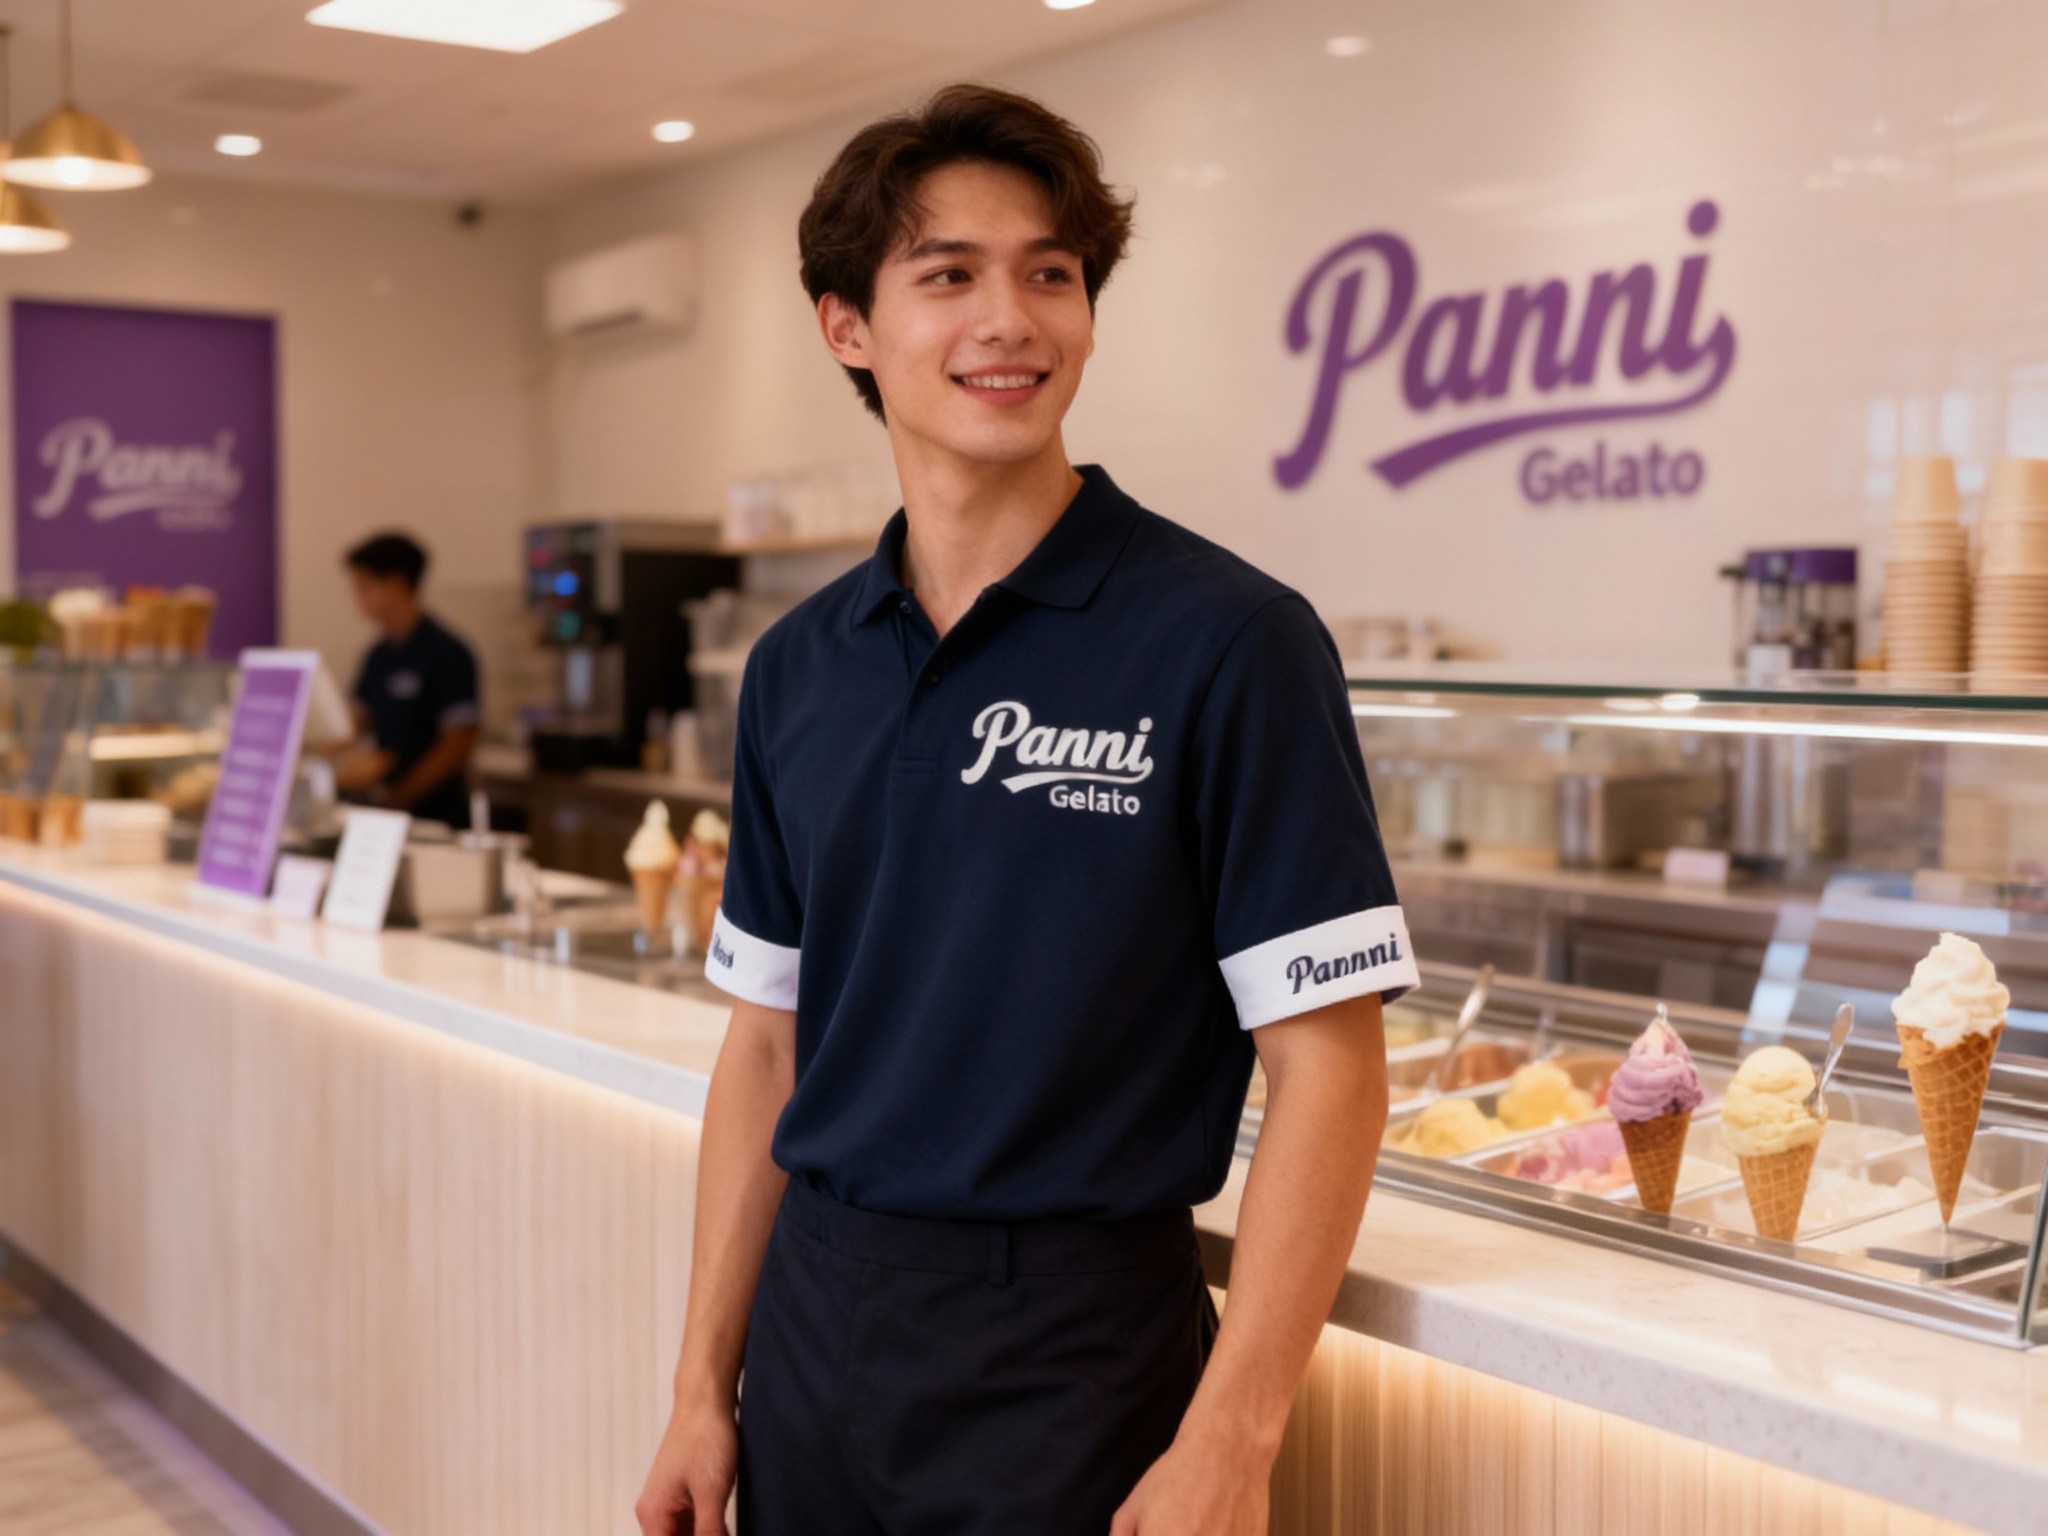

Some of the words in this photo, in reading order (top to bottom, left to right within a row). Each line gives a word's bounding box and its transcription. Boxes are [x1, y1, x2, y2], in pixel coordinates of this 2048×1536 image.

[1273, 200, 1736, 491] Panni
[1519, 442, 1705, 505] Gelato
[960, 700, 1154, 794] Panni
[1050, 784, 1141, 816] Gelato
